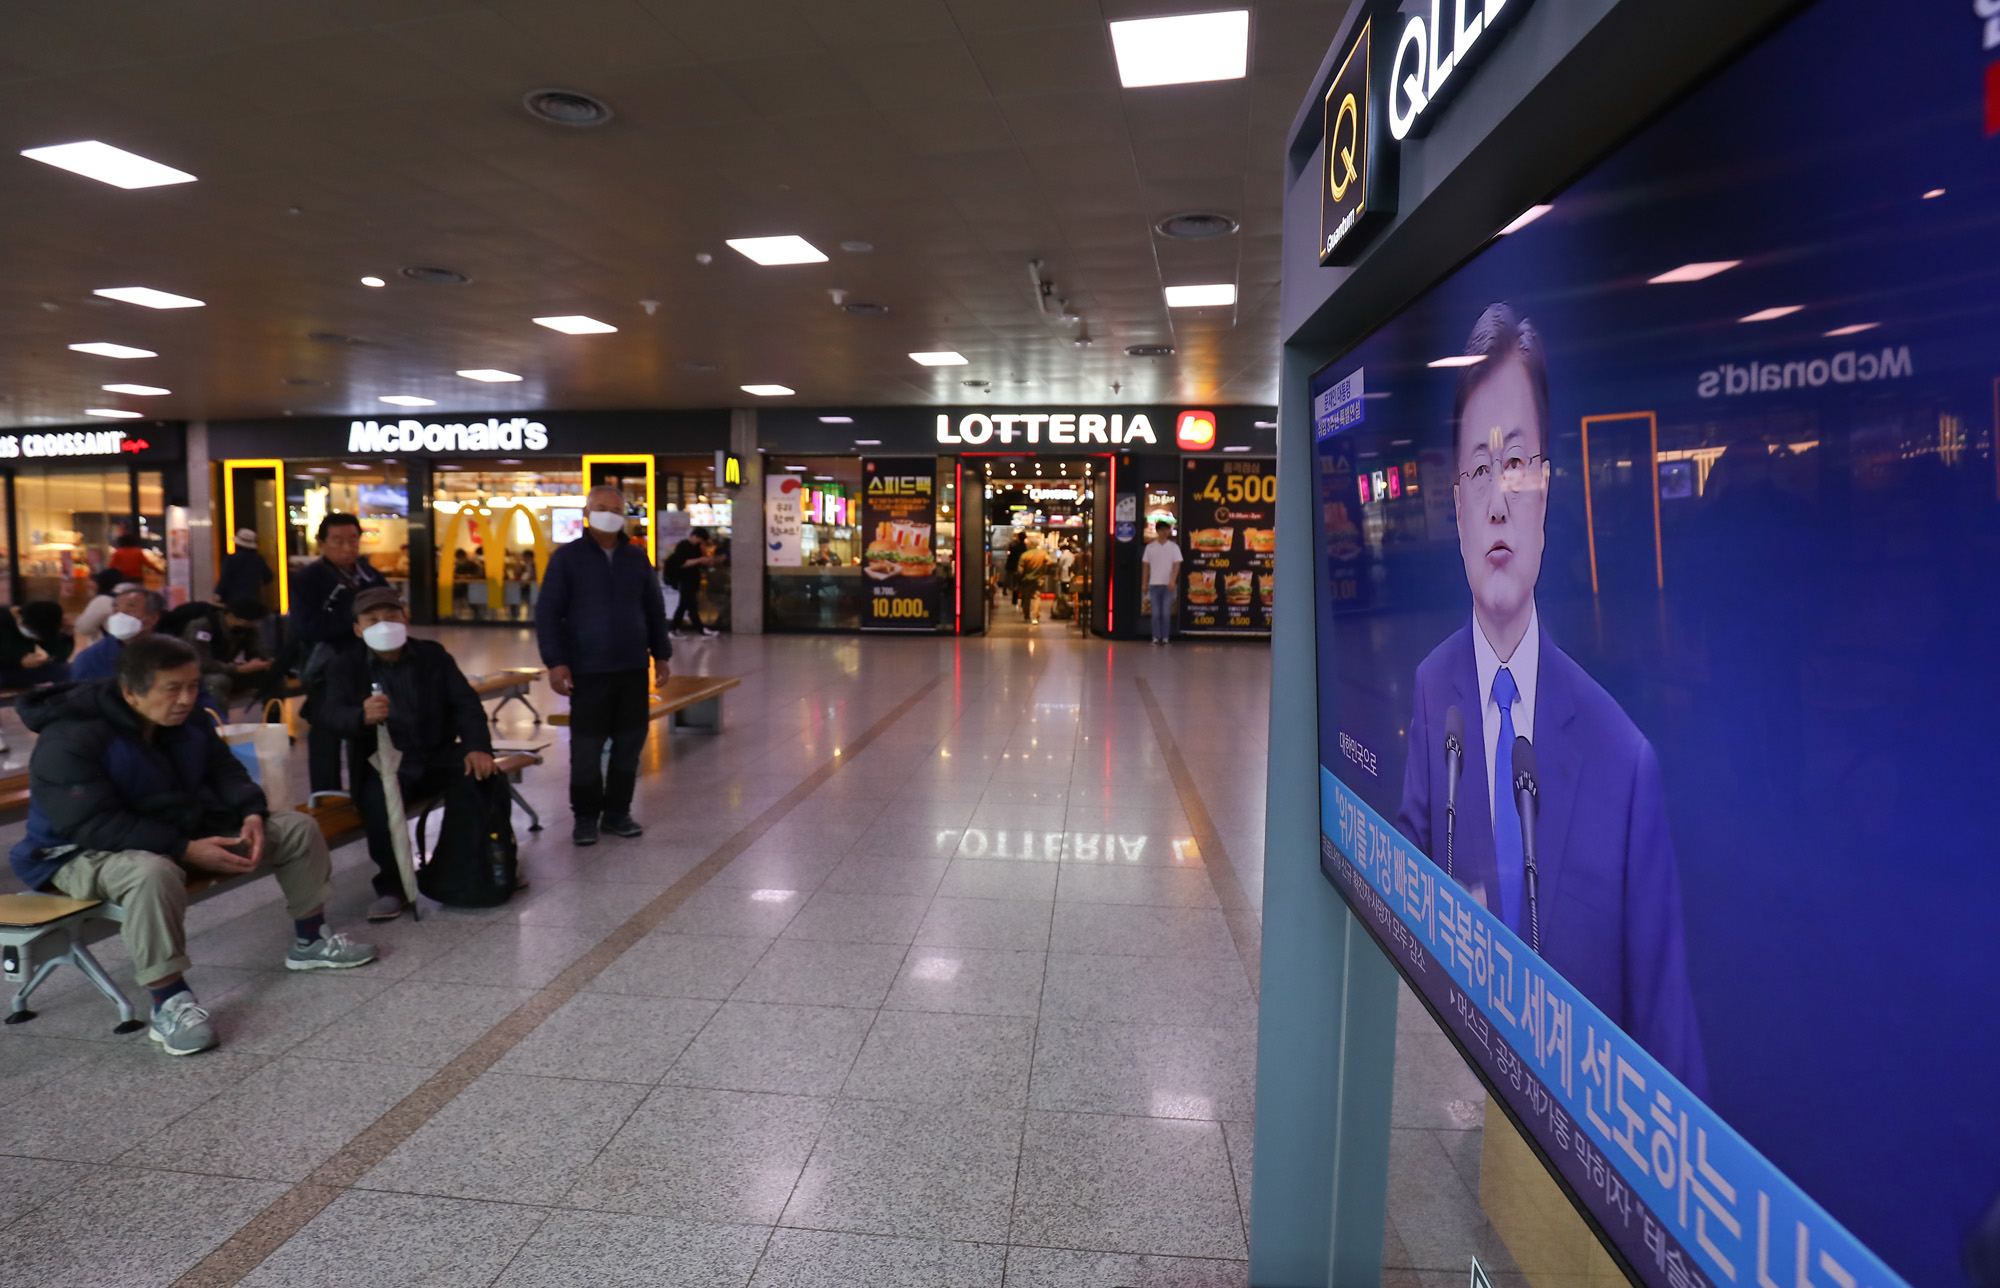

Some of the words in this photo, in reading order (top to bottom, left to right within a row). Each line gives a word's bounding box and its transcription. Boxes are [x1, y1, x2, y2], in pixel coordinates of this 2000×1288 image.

[1389, 0, 1507, 141] QL
[1330, 92, 1358, 203] Q
[1326, 208, 1355, 253] Quantum
[0, 434, 20, 458] IS
[22, 431, 123, 458] CROISSANT
[348, 418, 548, 452] McDonald's
[936, 413, 1157, 444] LOTTERIA
[867, 475, 932, 495] 스피드팩
[1339, 731, 1378, 777] 대한민국으로
[1341, 859, 1352, 886] 신규
[1393, 917, 1408, 951] 모두
[1409, 935, 1427, 974] 감소
[1368, 822, 1393, 896] 가장
[1394, 845, 1435, 946] 빠르게
[1439, 886, 1516, 1028] 극복하고
[1521, 967, 1573, 1101] 세계
[1580, 1024, 1742, 1283] 선도하는
[1457, 992, 1493, 1061] 머스크,
[1495, 1041, 1523, 1091] 공장
[1525, 1072, 1571, 1152] 재가동
[1574, 1132, 1632, 1228] 막히자
